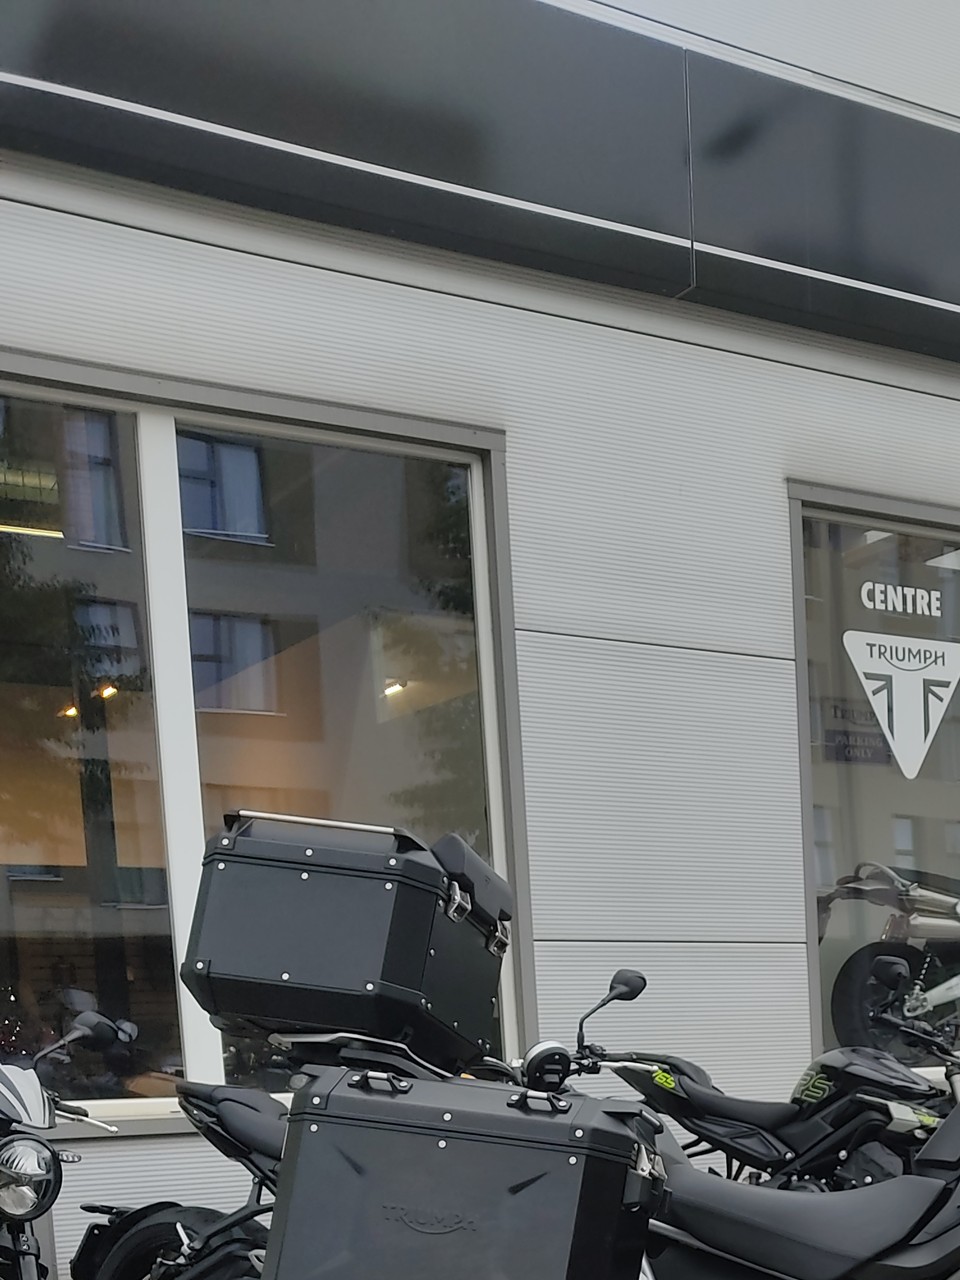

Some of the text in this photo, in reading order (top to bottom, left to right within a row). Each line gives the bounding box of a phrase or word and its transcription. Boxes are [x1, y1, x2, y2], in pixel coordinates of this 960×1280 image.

[860, 581, 942, 617] CENTRE
[865, 642, 945, 672] TRIUMPH
[834, 734, 884, 748] PARKING
[844, 746, 874, 759] ONLY
